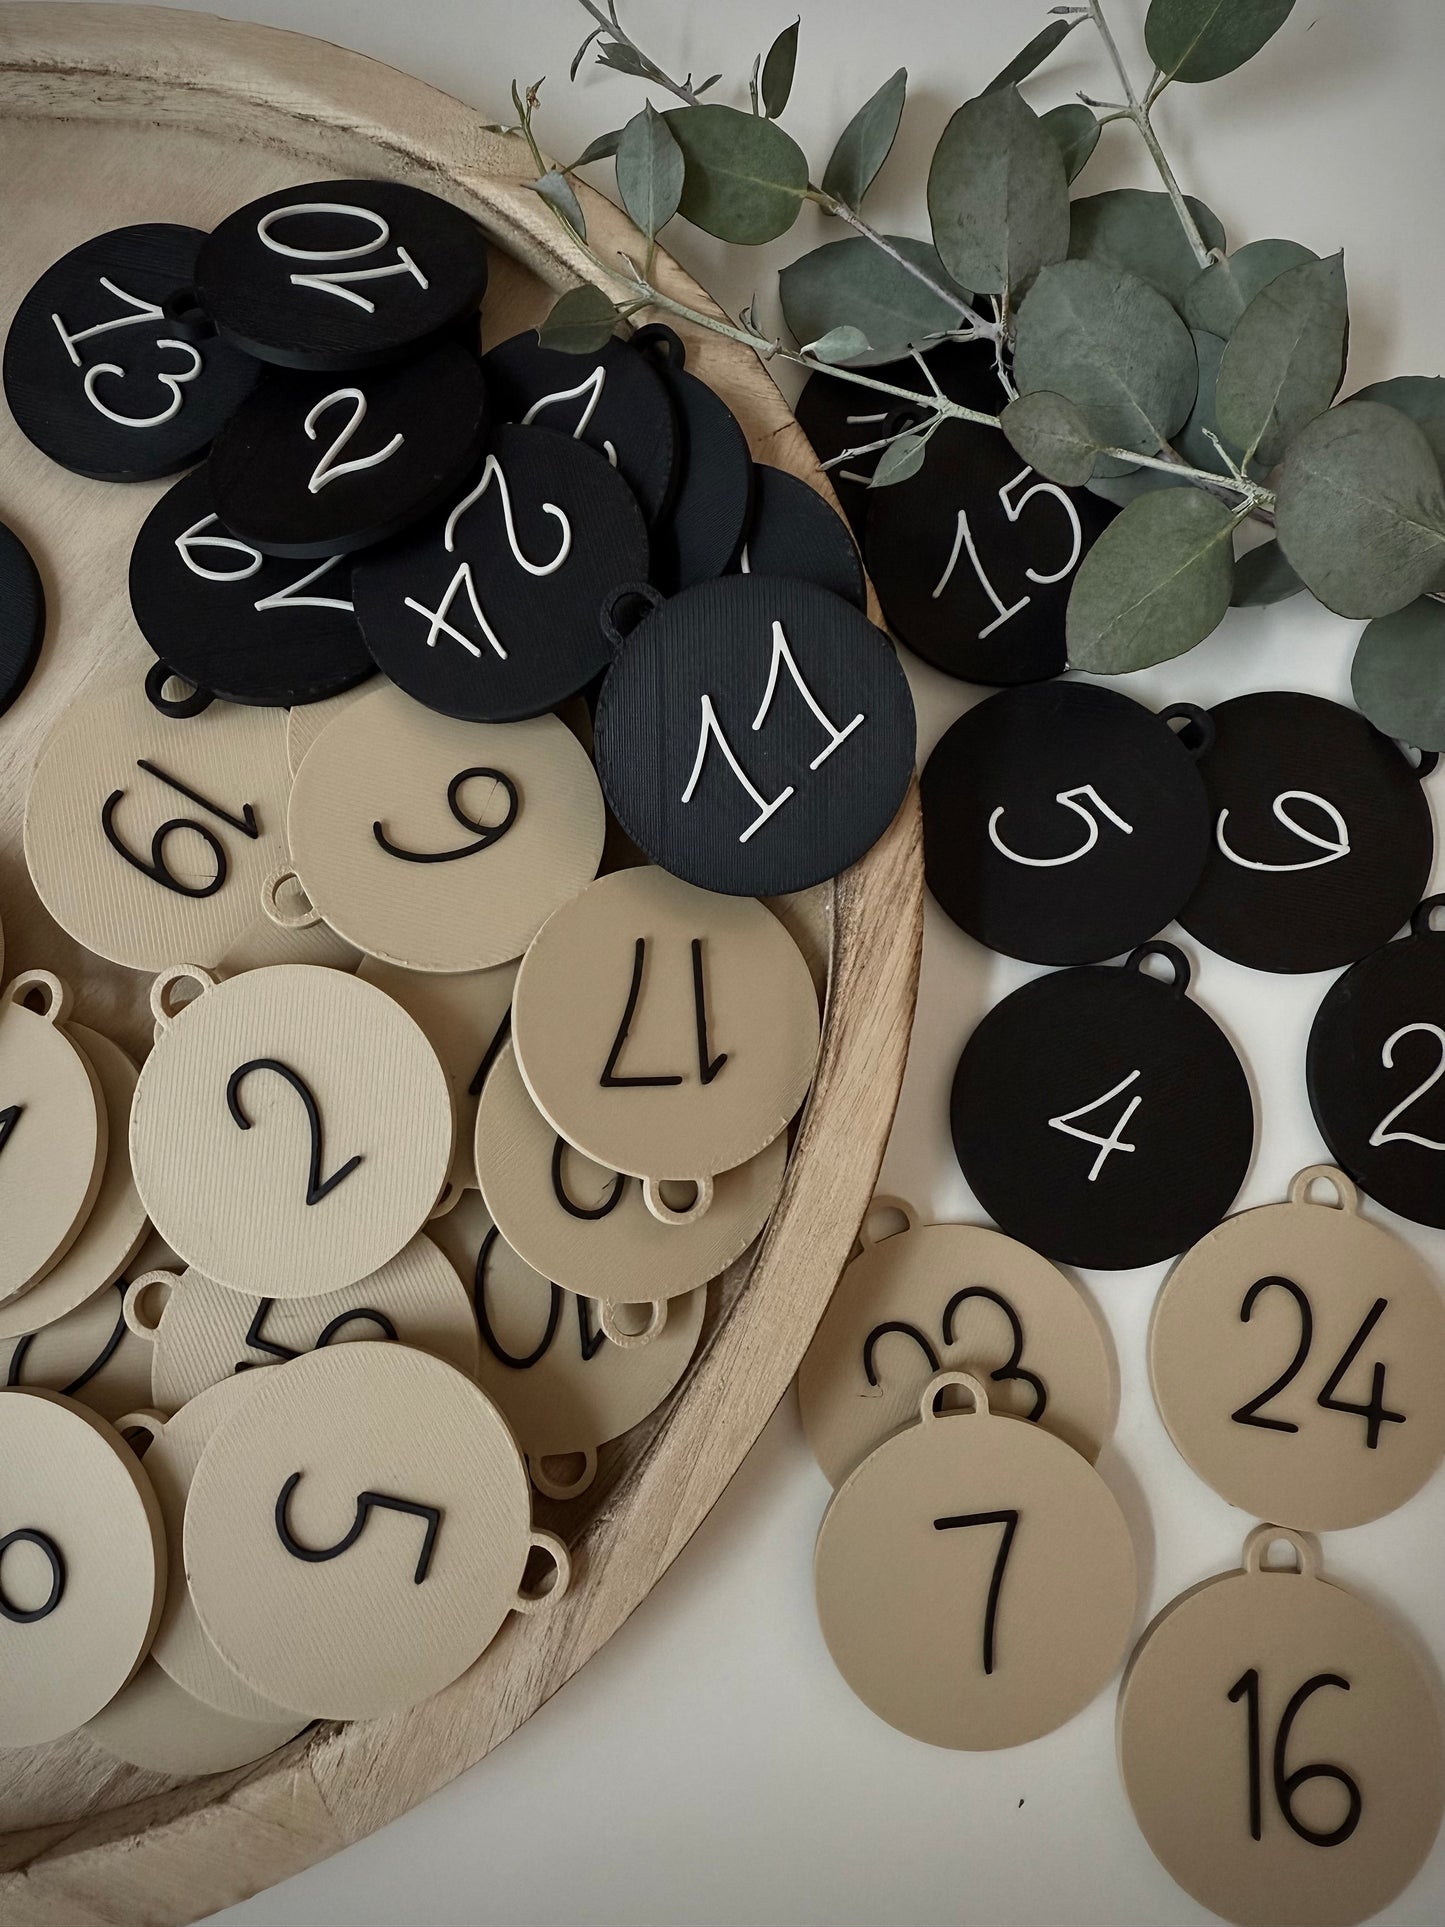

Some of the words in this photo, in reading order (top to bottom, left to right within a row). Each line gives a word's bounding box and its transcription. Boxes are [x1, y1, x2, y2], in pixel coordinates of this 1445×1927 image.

[257, 202, 429, 314] 10
[51, 276, 202, 428] 13
[303, 387, 405, 494] 2
[403, 453, 571, 660] 24
[930, 465, 1084, 641] 15
[682, 620, 866, 844] 11
[988, 784, 1134, 867] 5
[599, 937, 729, 1088] 17
[226, 1057, 364, 1206] 2
[1047, 1068, 1143, 1182] 4
[1230, 1274, 1408, 1450] 24
[274, 1471, 441, 1585] 5
[932, 1509, 1019, 1675] 7
[1227, 1667, 1363, 1848] 16
